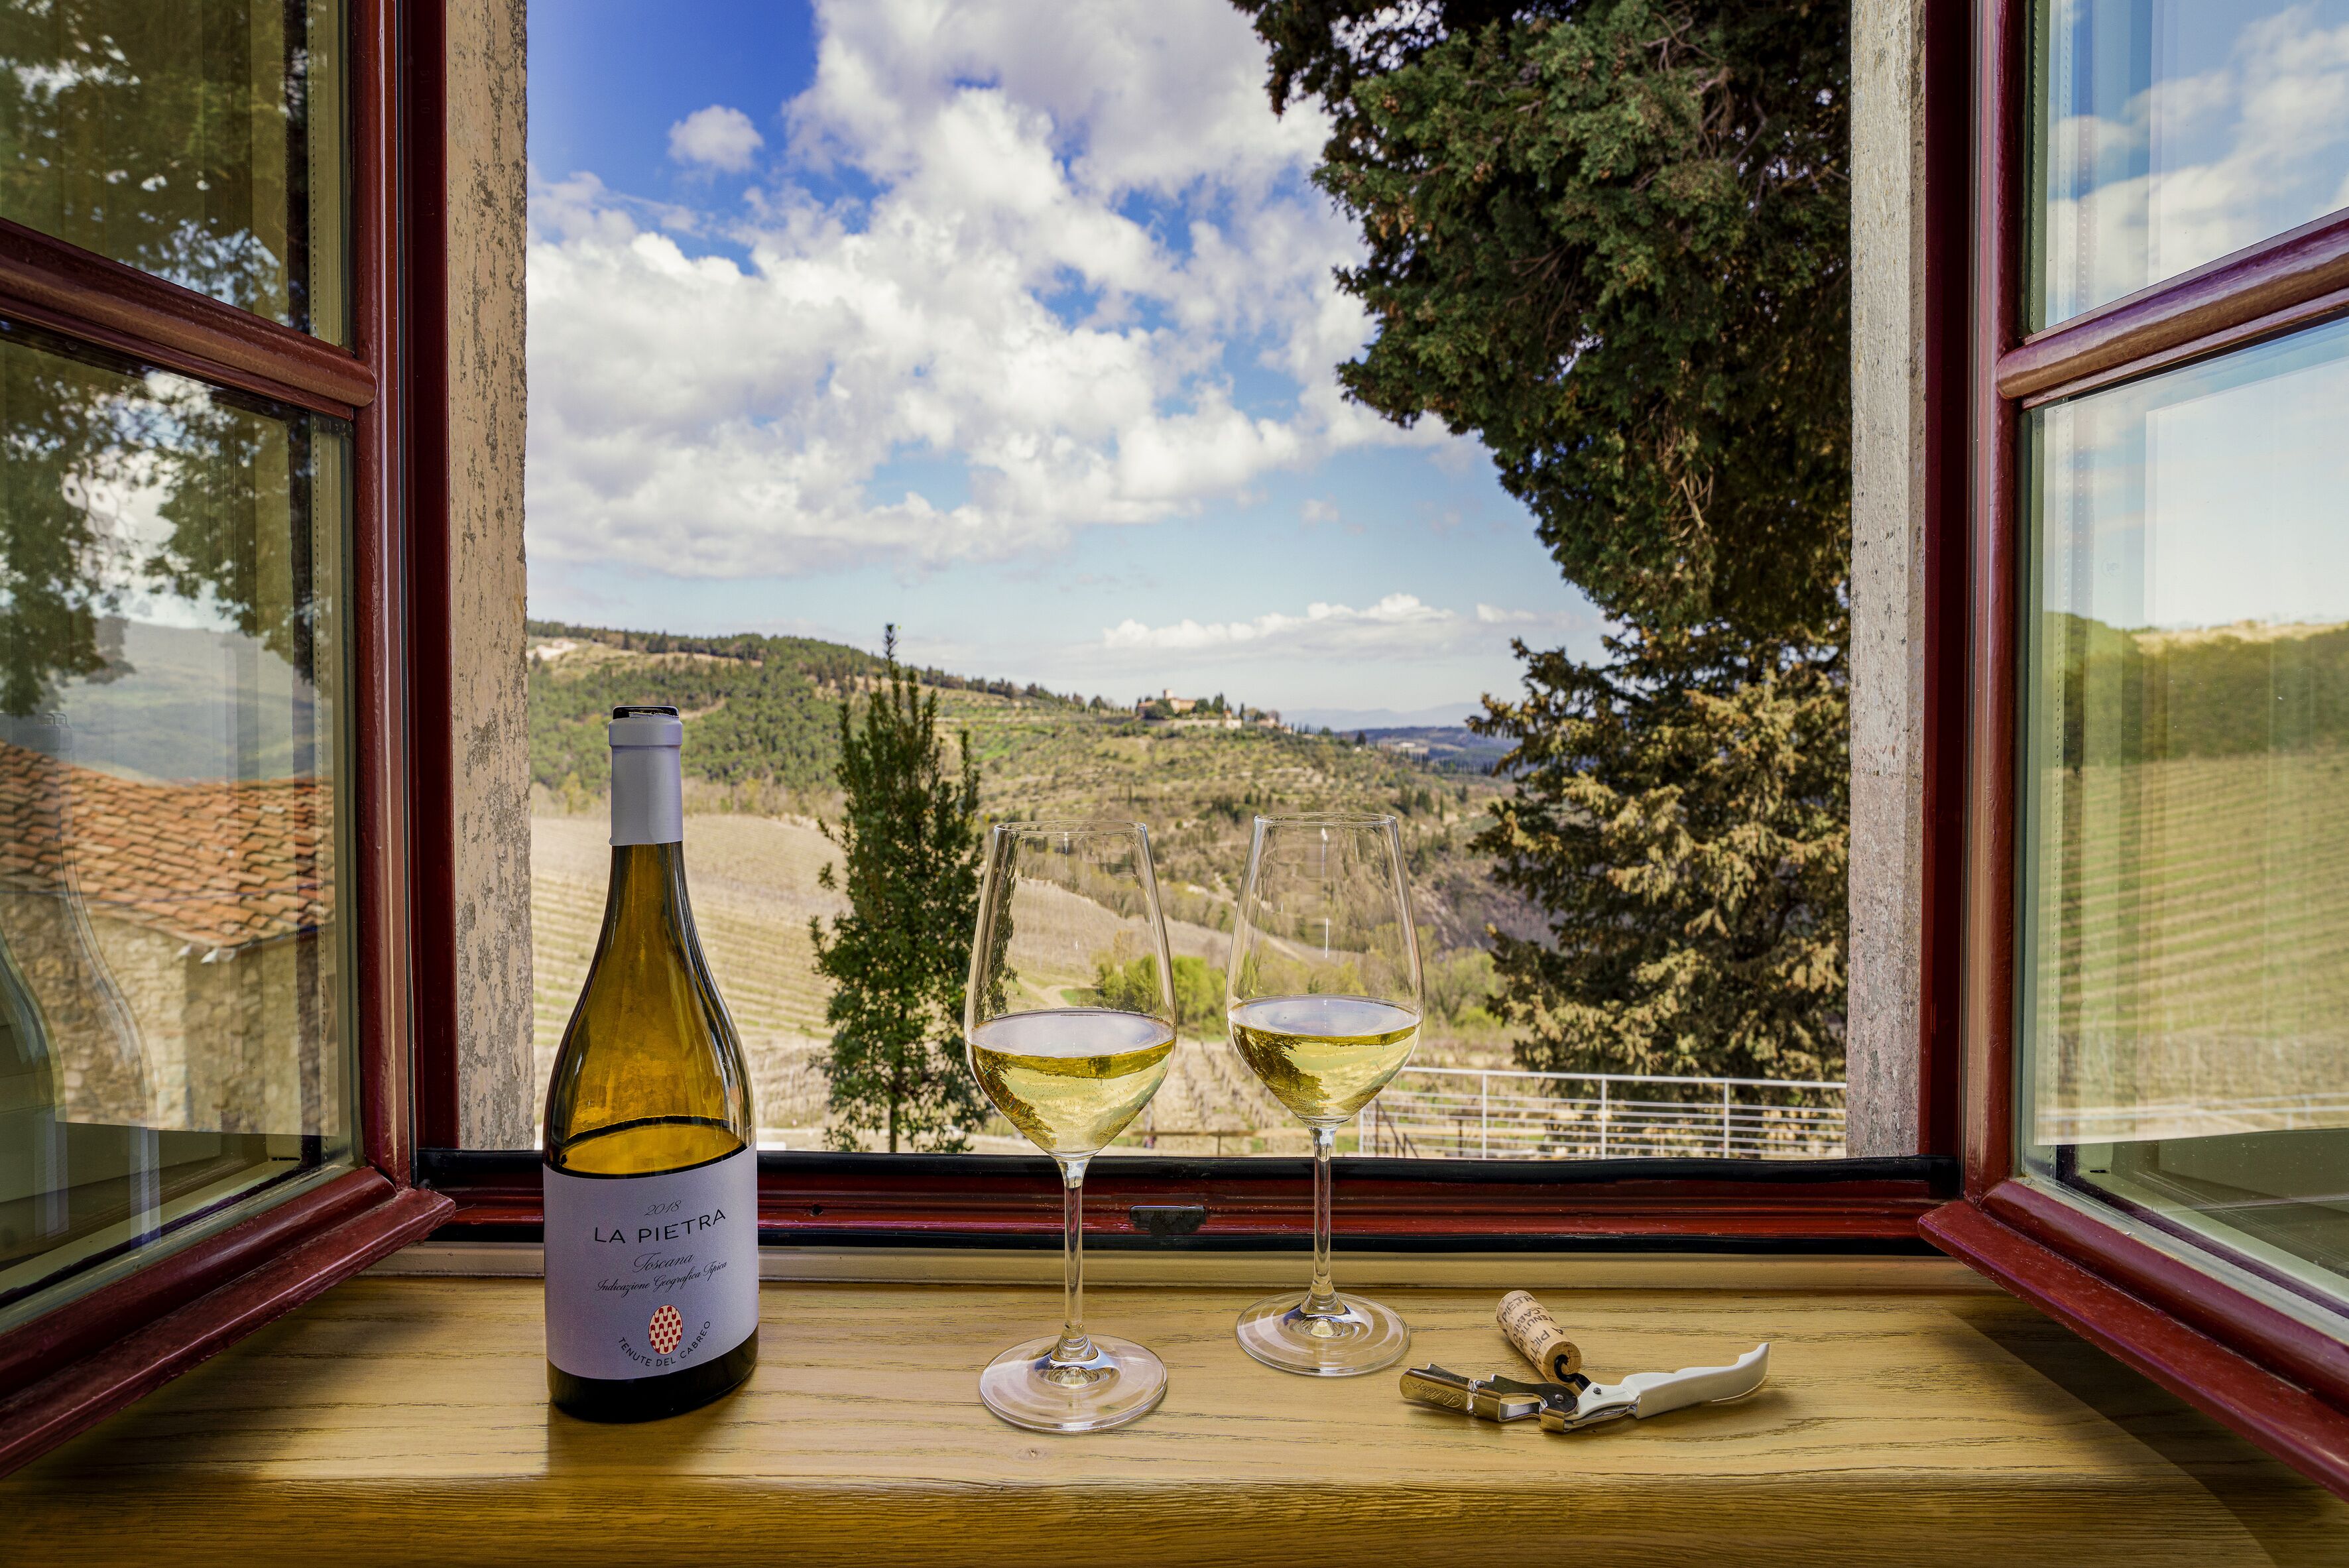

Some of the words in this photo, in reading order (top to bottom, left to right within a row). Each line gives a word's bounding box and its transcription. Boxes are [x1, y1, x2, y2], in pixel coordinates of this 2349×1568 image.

[643, 1199, 682, 1217] 2018
[594, 1227, 626, 1244] LA
[638, 1209, 727, 1243] PIETRA
[632, 1252, 695, 1273] Toscana
[596, 1278, 650, 1298] Indicazione
[652, 1266, 701, 1293] Geografica
[703, 1260, 727, 1282] Tipica
[1502, 1296, 1537, 1323] PIETR
[619, 1337, 652, 1366] TENUTE
[656, 1357, 676, 1366] DEL
[680, 1321, 711, 1358] CABREO
